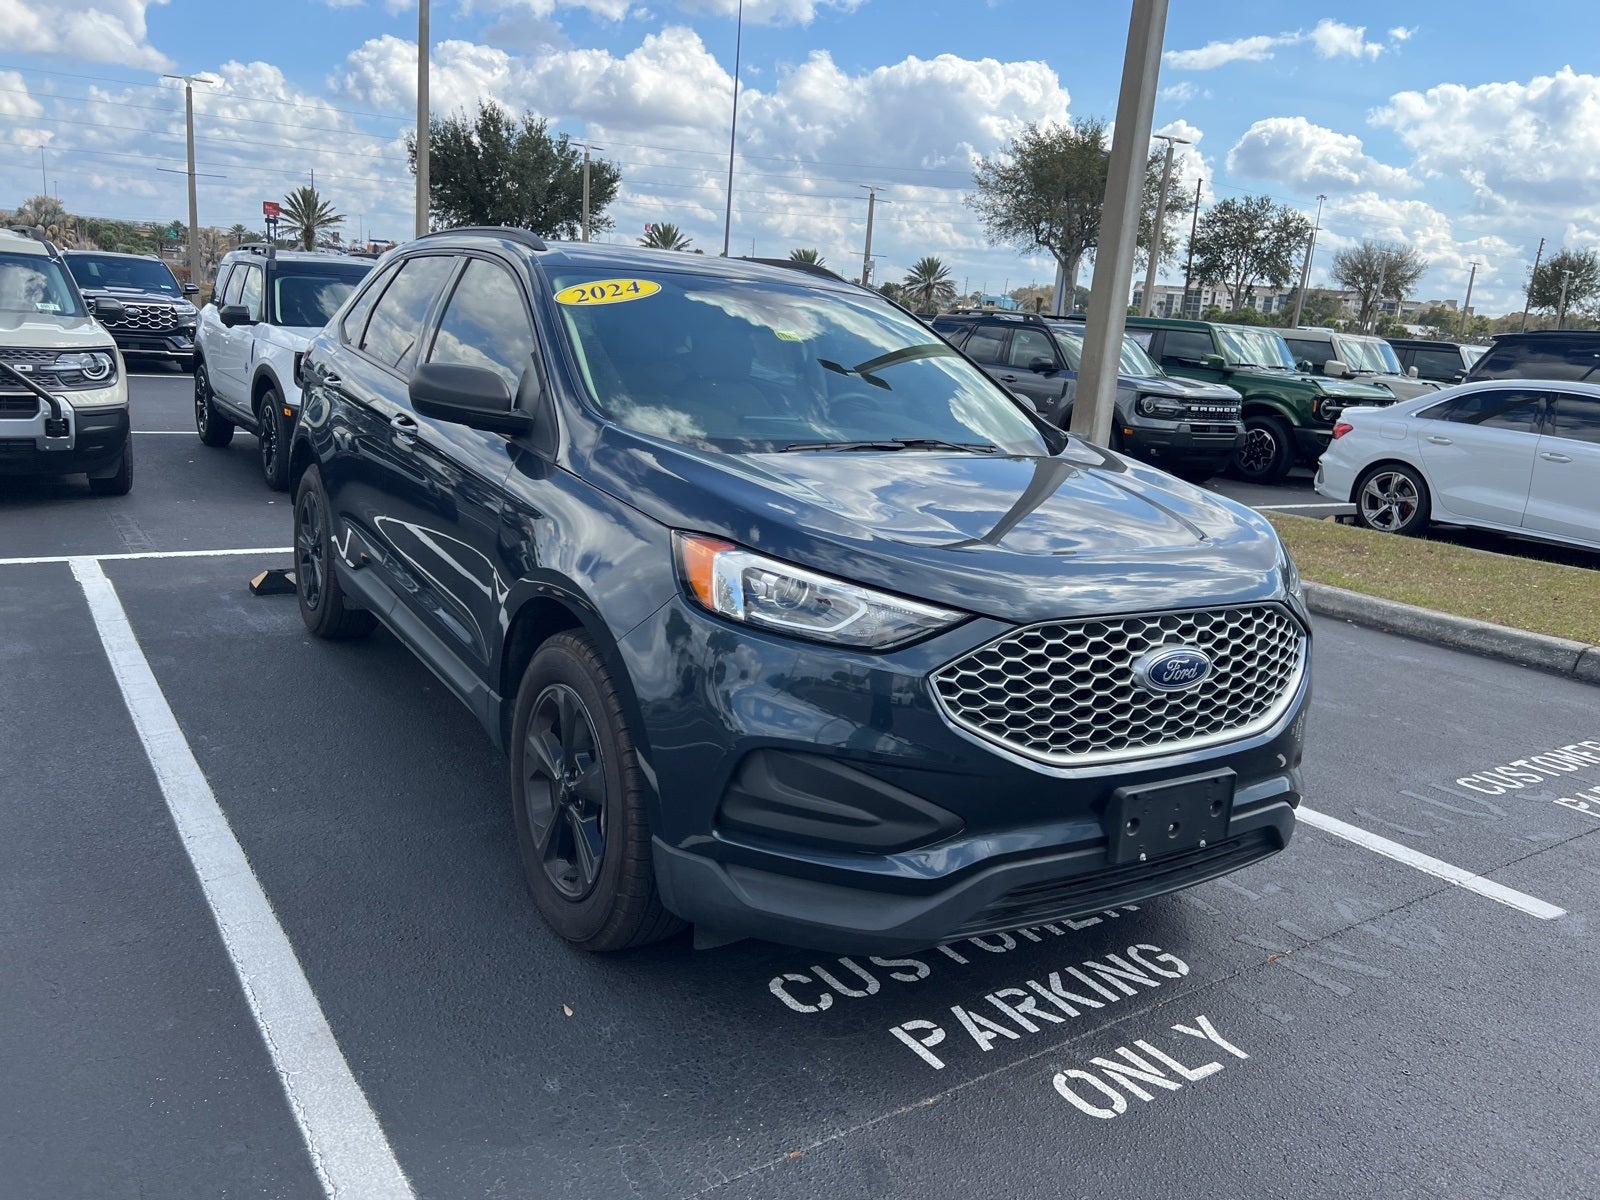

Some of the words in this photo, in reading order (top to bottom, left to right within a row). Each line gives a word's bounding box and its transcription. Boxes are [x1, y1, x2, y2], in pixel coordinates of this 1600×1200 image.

[573, 281, 641, 303] 2024
[1162, 659, 1199, 683] Ford
[889, 943, 1191, 1071] PARKING
[1052, 1014, 1251, 1120] ONLY
